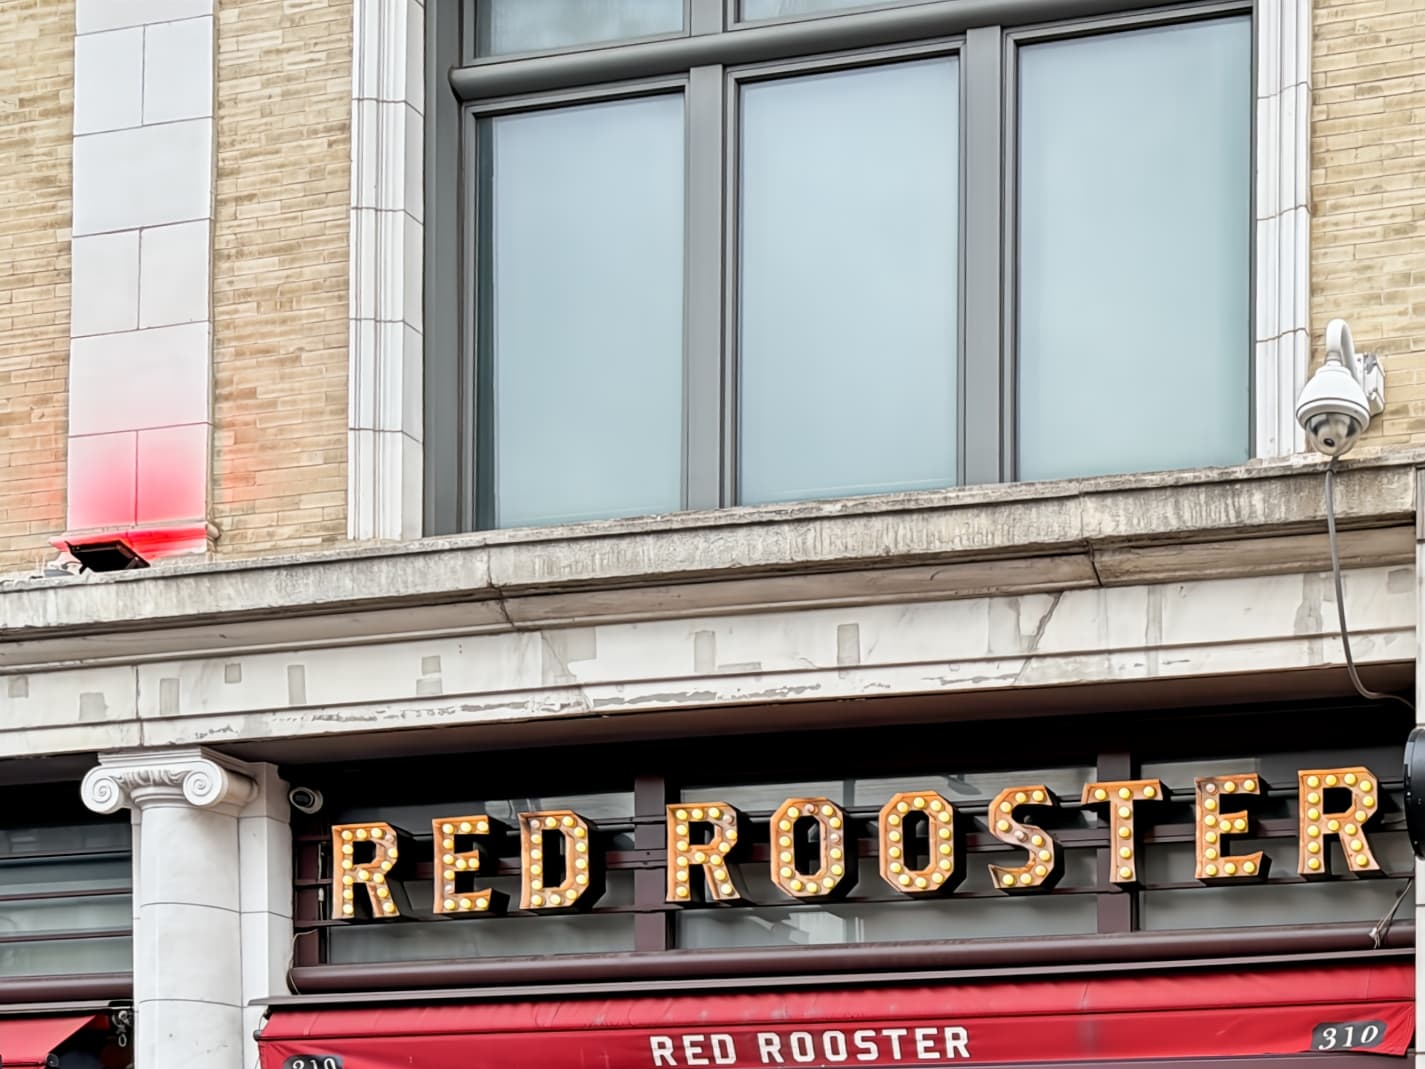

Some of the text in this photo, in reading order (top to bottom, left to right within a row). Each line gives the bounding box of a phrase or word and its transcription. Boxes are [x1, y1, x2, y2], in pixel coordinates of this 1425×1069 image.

[331, 808, 594, 920] RED
[665, 765, 1384, 904] ROOSTER
[650, 1026, 971, 1067] RED ROOSTER
[1318, 1024, 1379, 1050] 310
